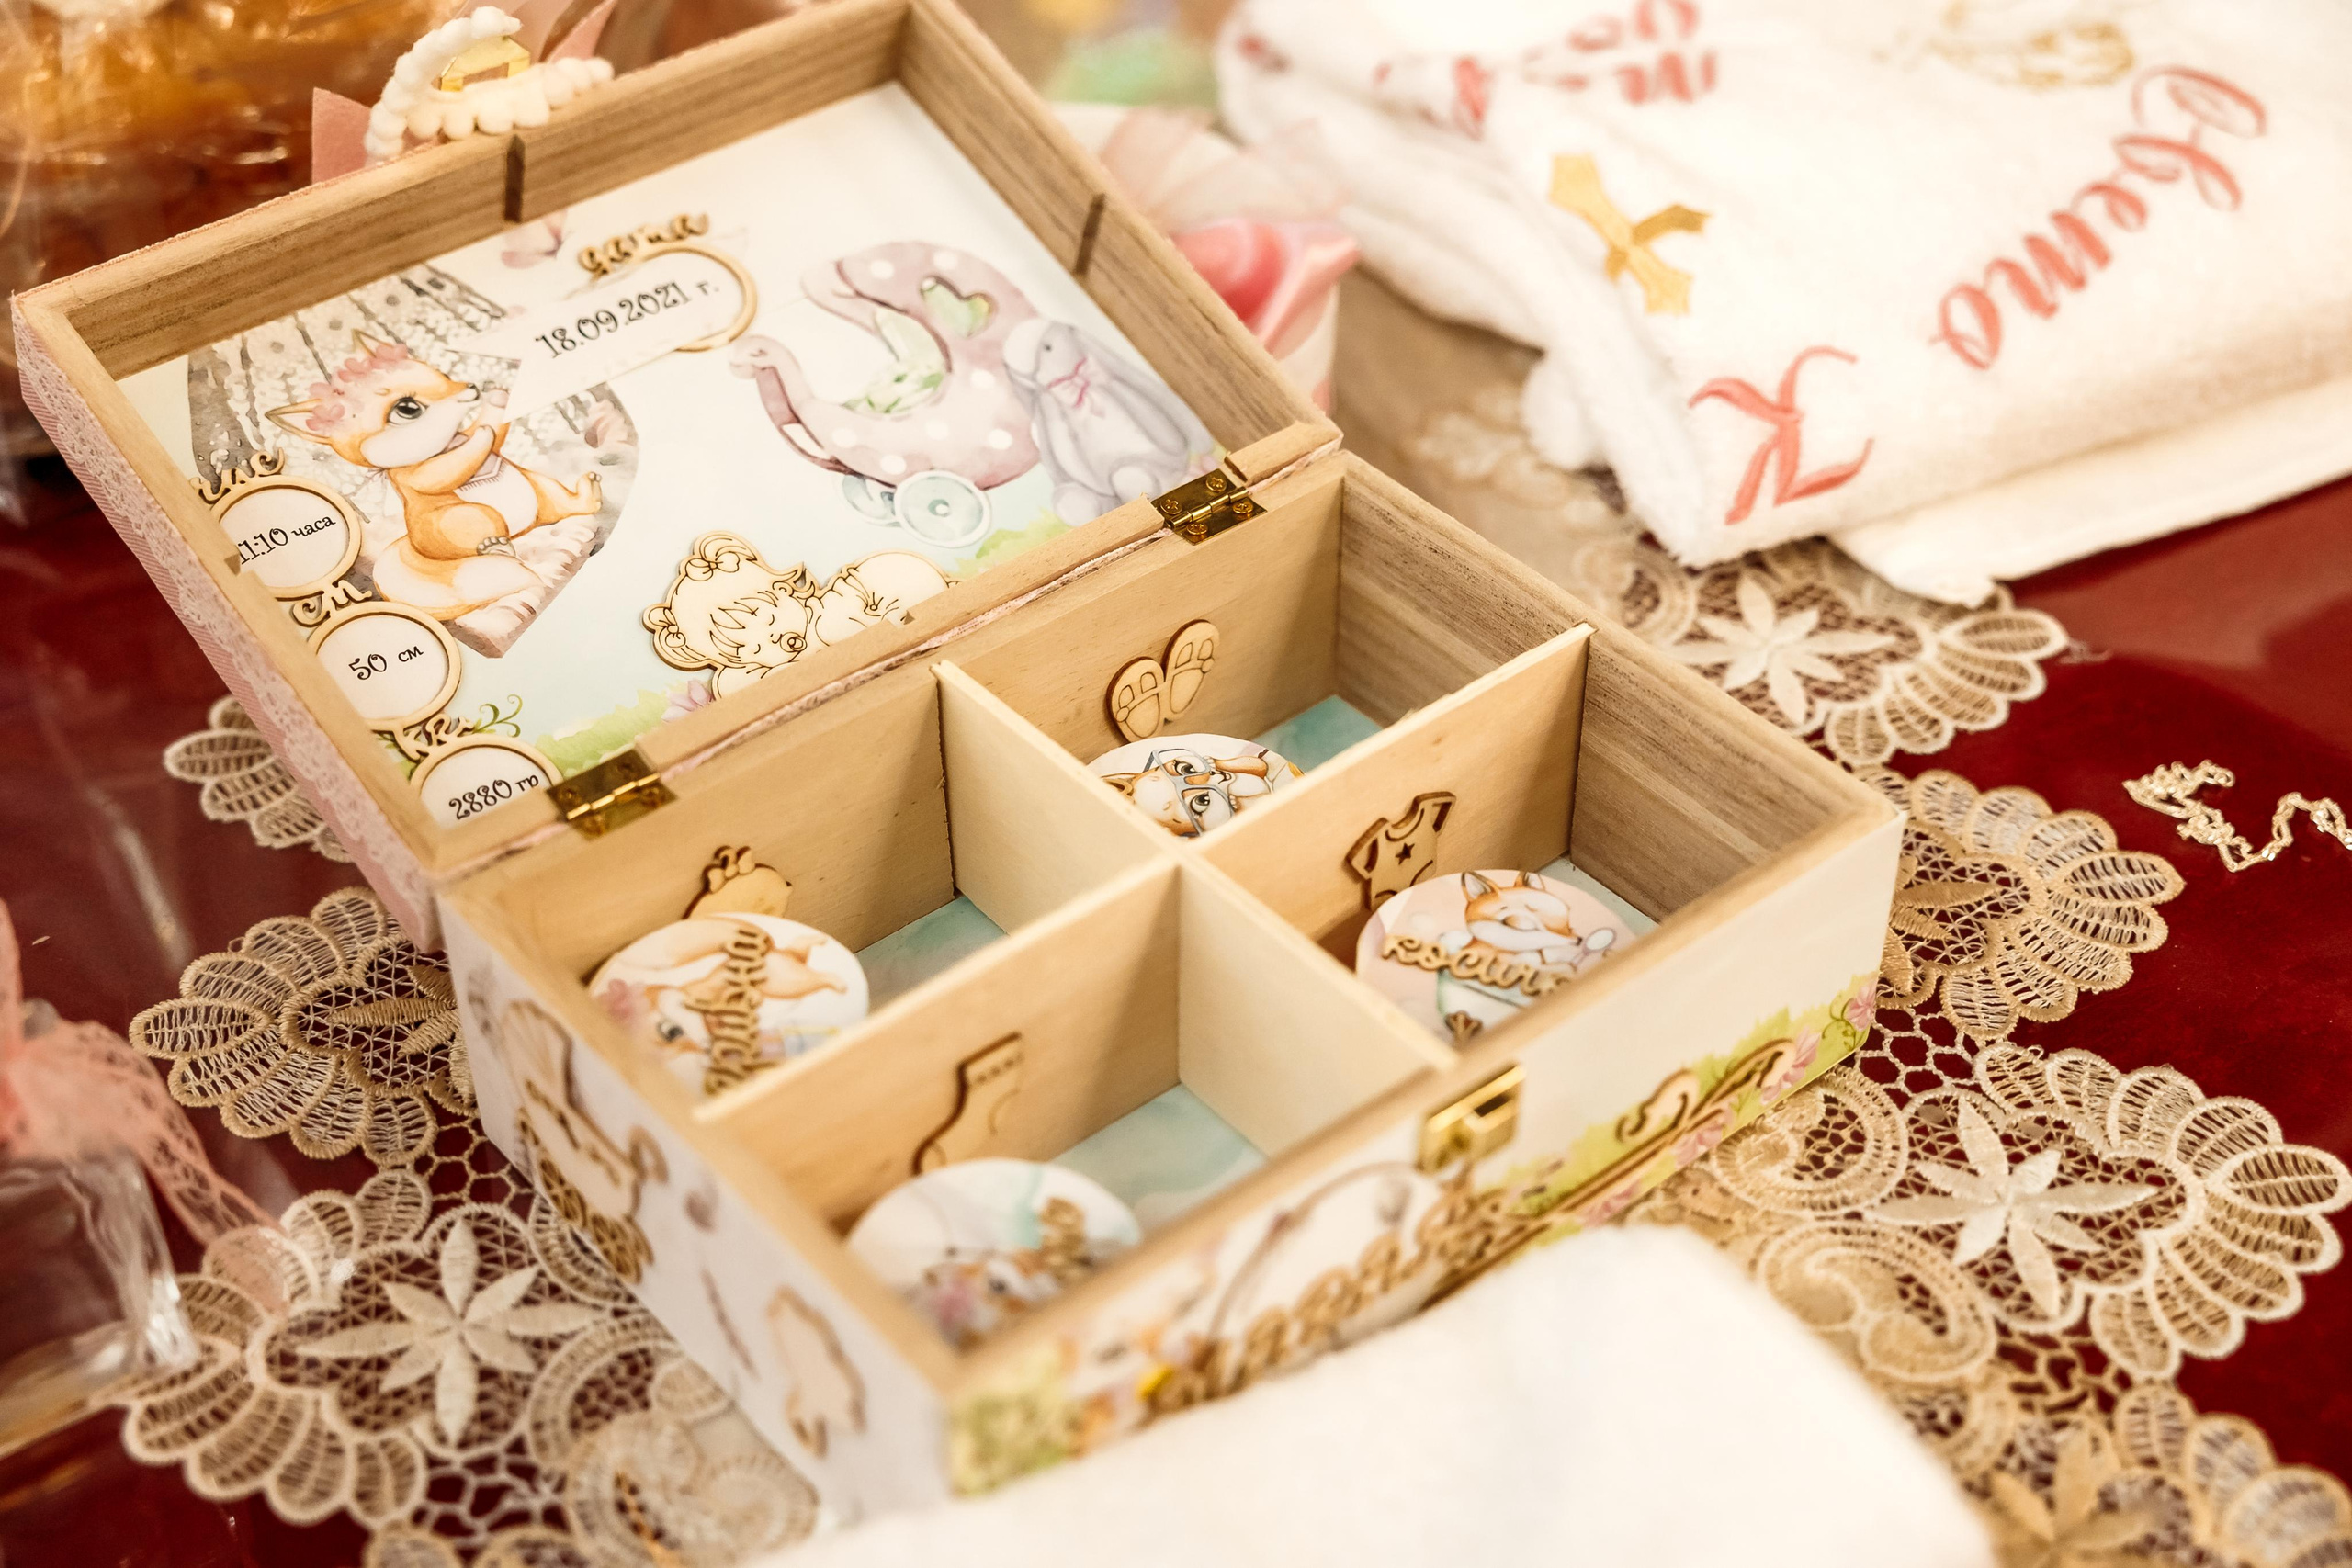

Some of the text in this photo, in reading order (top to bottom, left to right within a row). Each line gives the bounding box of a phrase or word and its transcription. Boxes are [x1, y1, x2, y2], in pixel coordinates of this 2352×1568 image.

[535, 282, 692, 358] 18.09.2021
[237, 516, 336, 564] 11:10 часа
[348, 646, 424, 680] 50 см
[448, 774, 539, 819] 2880 гр
